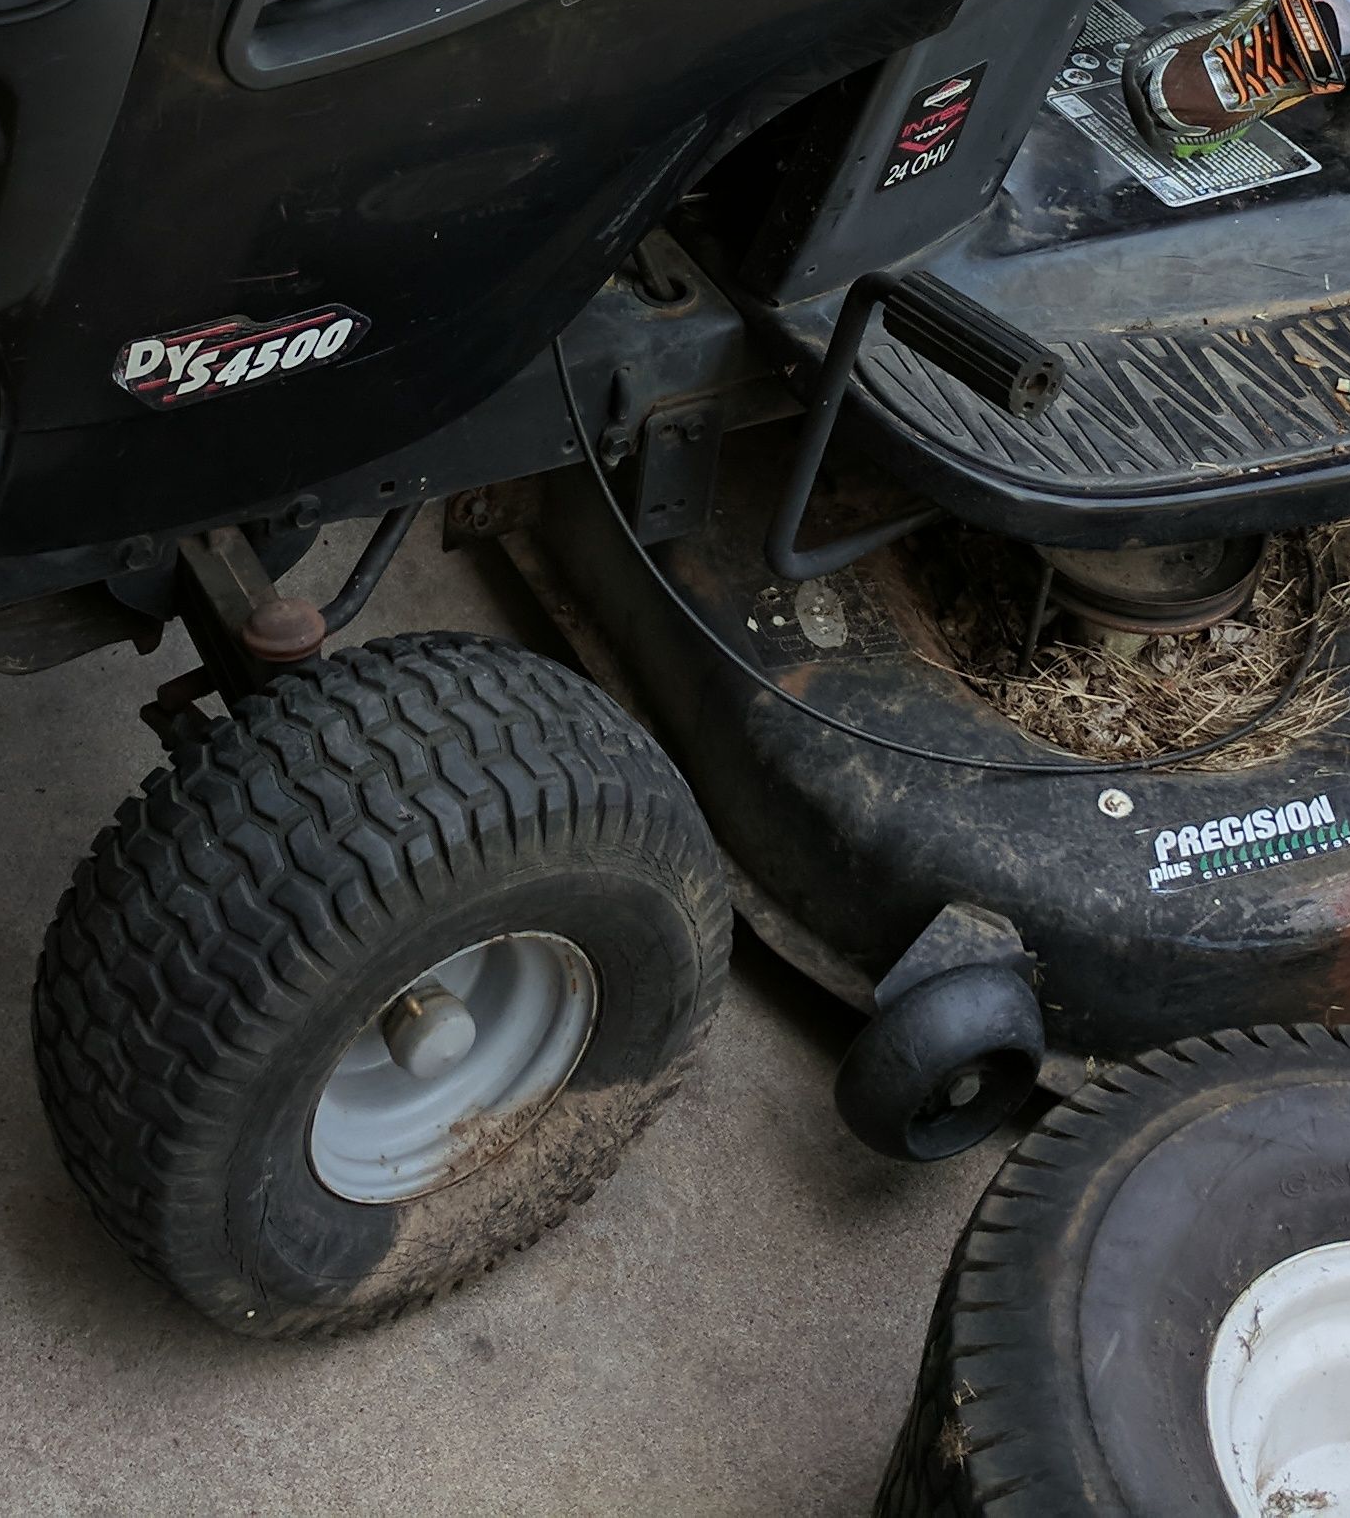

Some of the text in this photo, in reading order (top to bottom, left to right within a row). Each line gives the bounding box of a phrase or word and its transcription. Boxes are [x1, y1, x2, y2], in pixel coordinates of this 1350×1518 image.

[901, 97, 972, 138] INTEK
[883, 139, 955, 187] 24 OHV
[1154, 794, 1336, 860] PRECISION
[1148, 860, 1192, 888] plus
[1202, 850, 1295, 880] CUTTING
